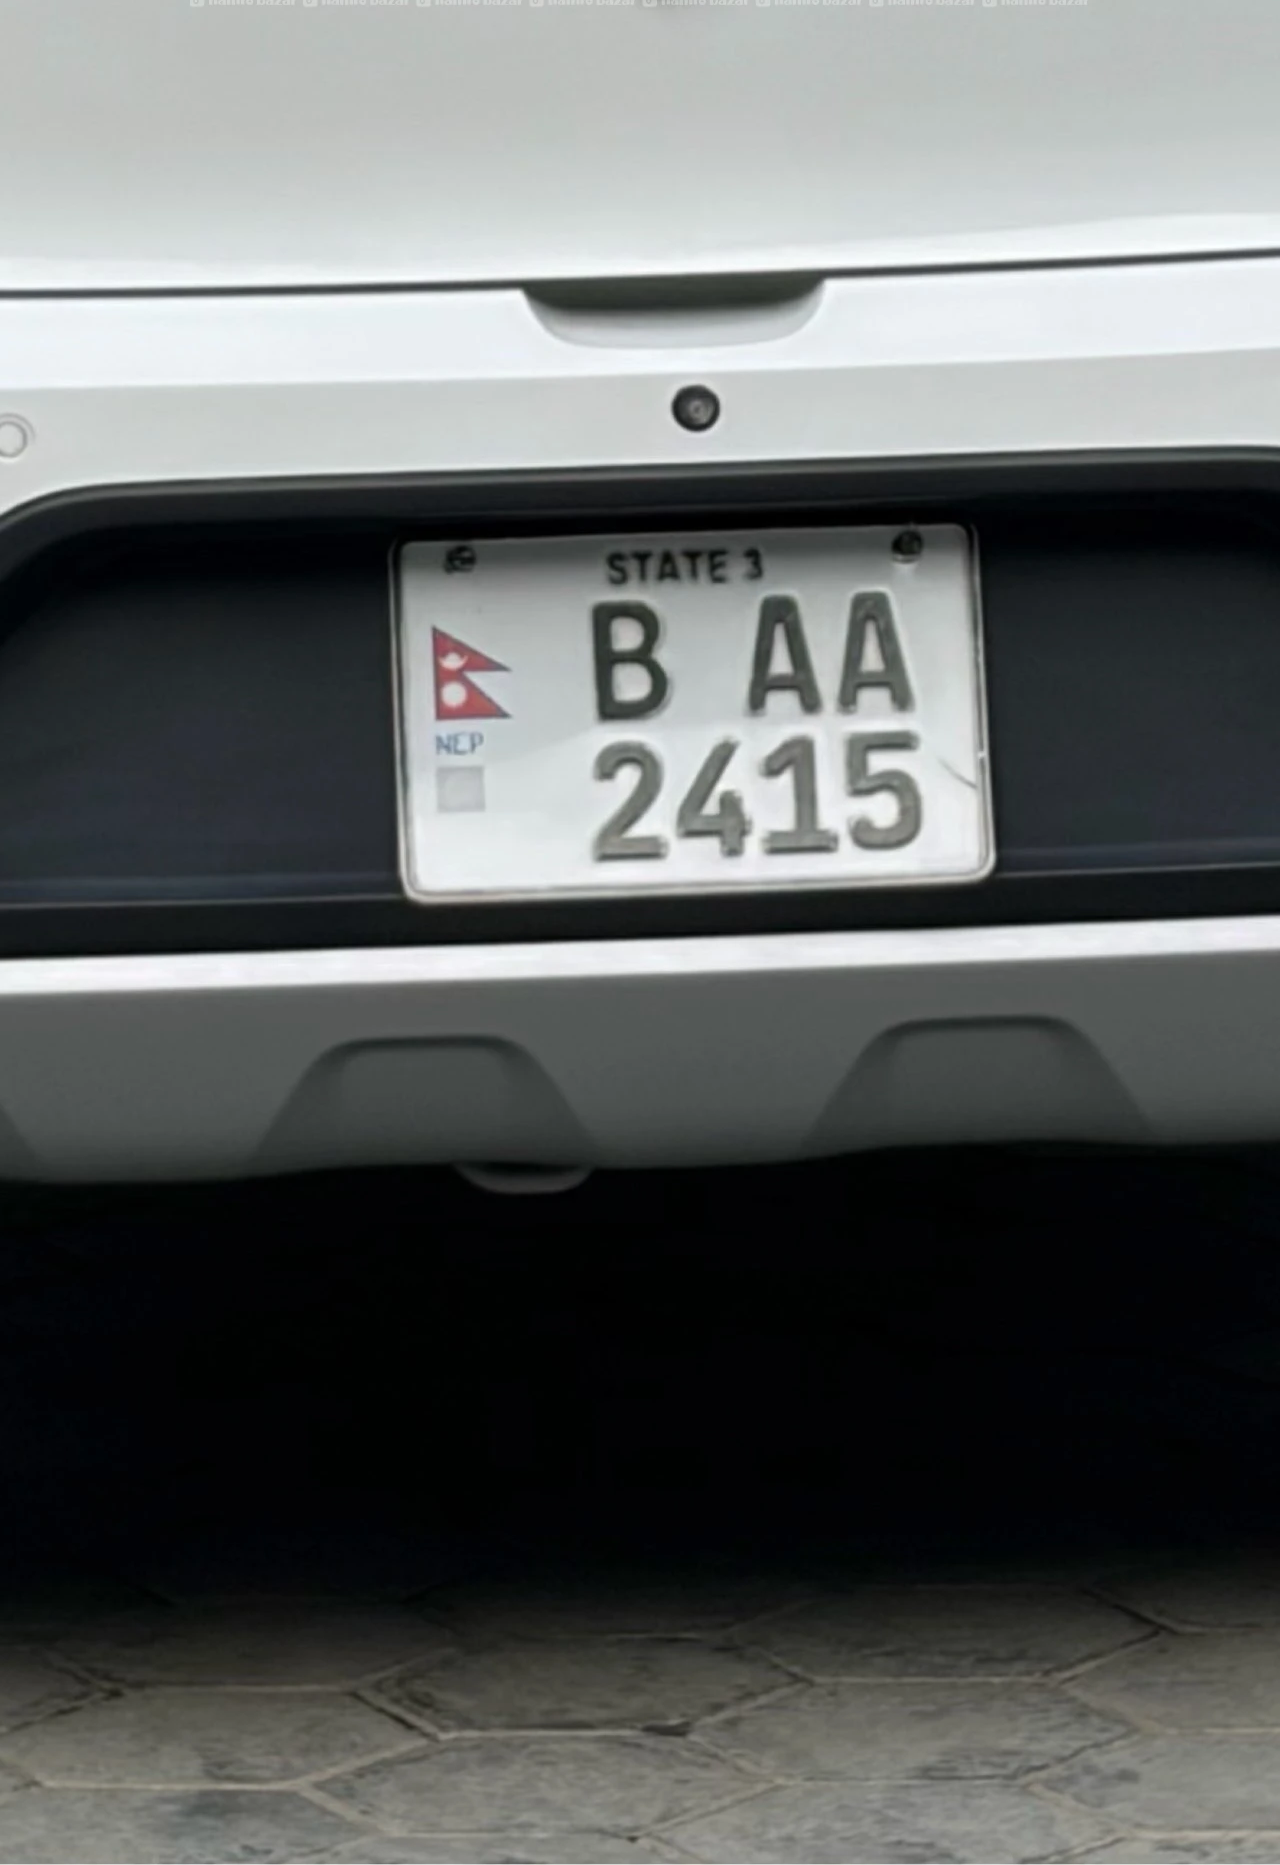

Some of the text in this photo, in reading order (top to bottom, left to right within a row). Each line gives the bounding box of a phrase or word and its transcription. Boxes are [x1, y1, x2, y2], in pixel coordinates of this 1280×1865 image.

[606, 548, 766, 585] STATE 3
[591, 590, 916, 723] B AA
[434, 734, 486, 756] NEP
[592, 729, 923, 863] 2415
